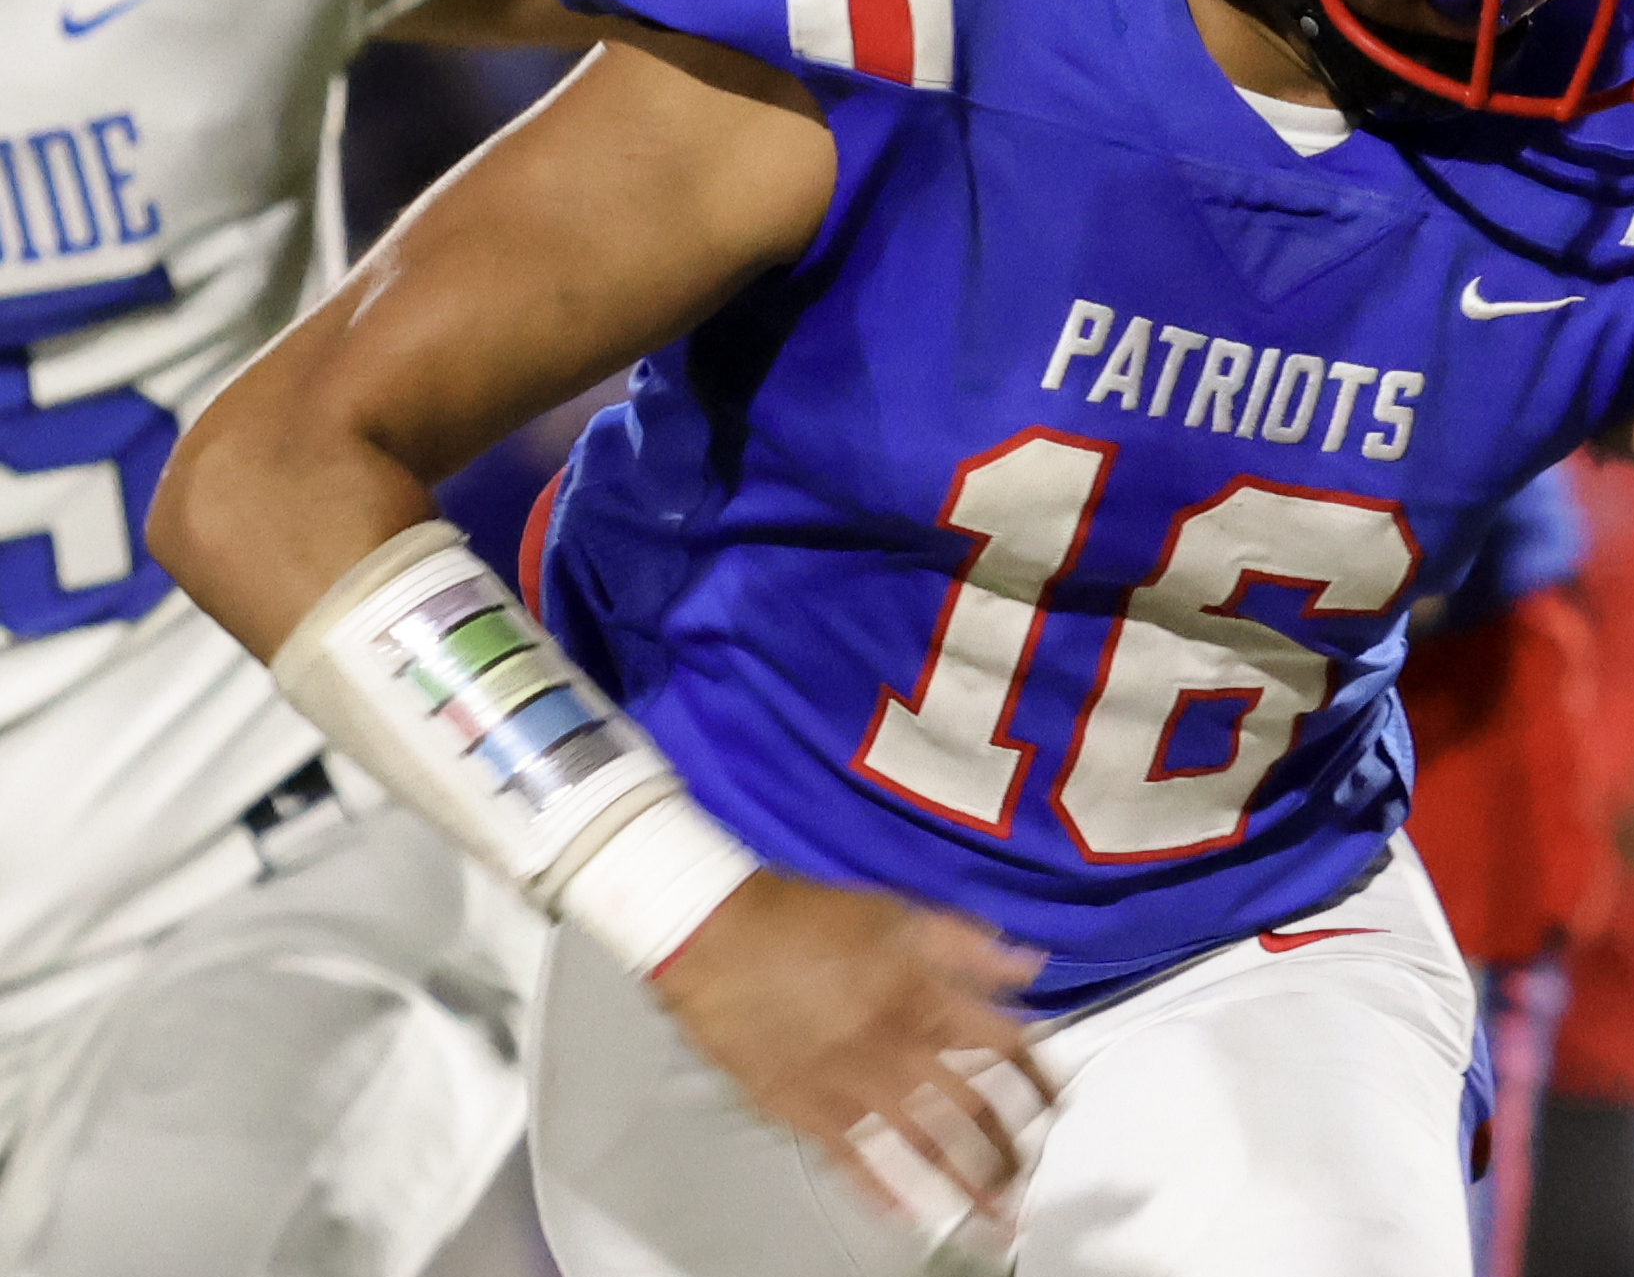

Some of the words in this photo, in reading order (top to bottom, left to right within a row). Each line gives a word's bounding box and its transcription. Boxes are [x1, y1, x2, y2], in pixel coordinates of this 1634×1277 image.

[0, 113, 160, 264] IDE
[1040, 298, 1425, 462] PATRIOTS
[848, 423, 1424, 865] 16
